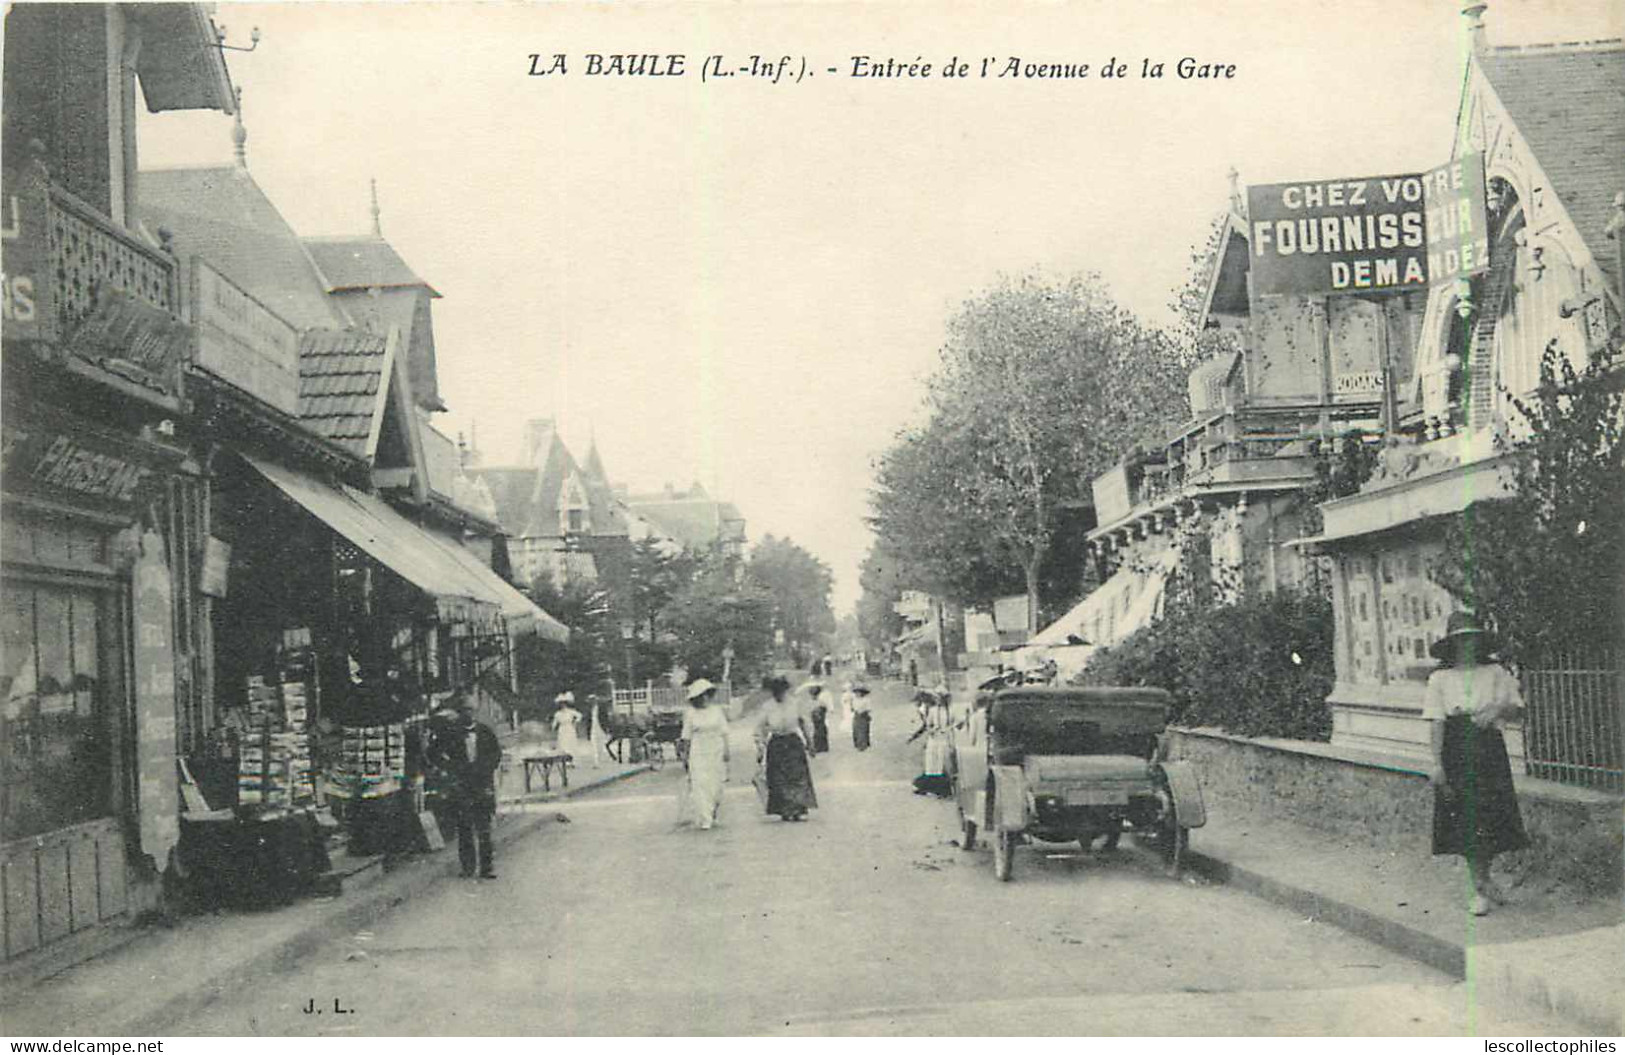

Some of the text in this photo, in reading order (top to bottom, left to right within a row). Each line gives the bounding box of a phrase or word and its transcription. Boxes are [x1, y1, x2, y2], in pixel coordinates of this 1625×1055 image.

[1282, 161, 1462, 210] CHEZ VOTRE
[1253, 196, 1473, 257] FOURNISSEUR
[1331, 238, 1490, 289] DEMANDEZ
